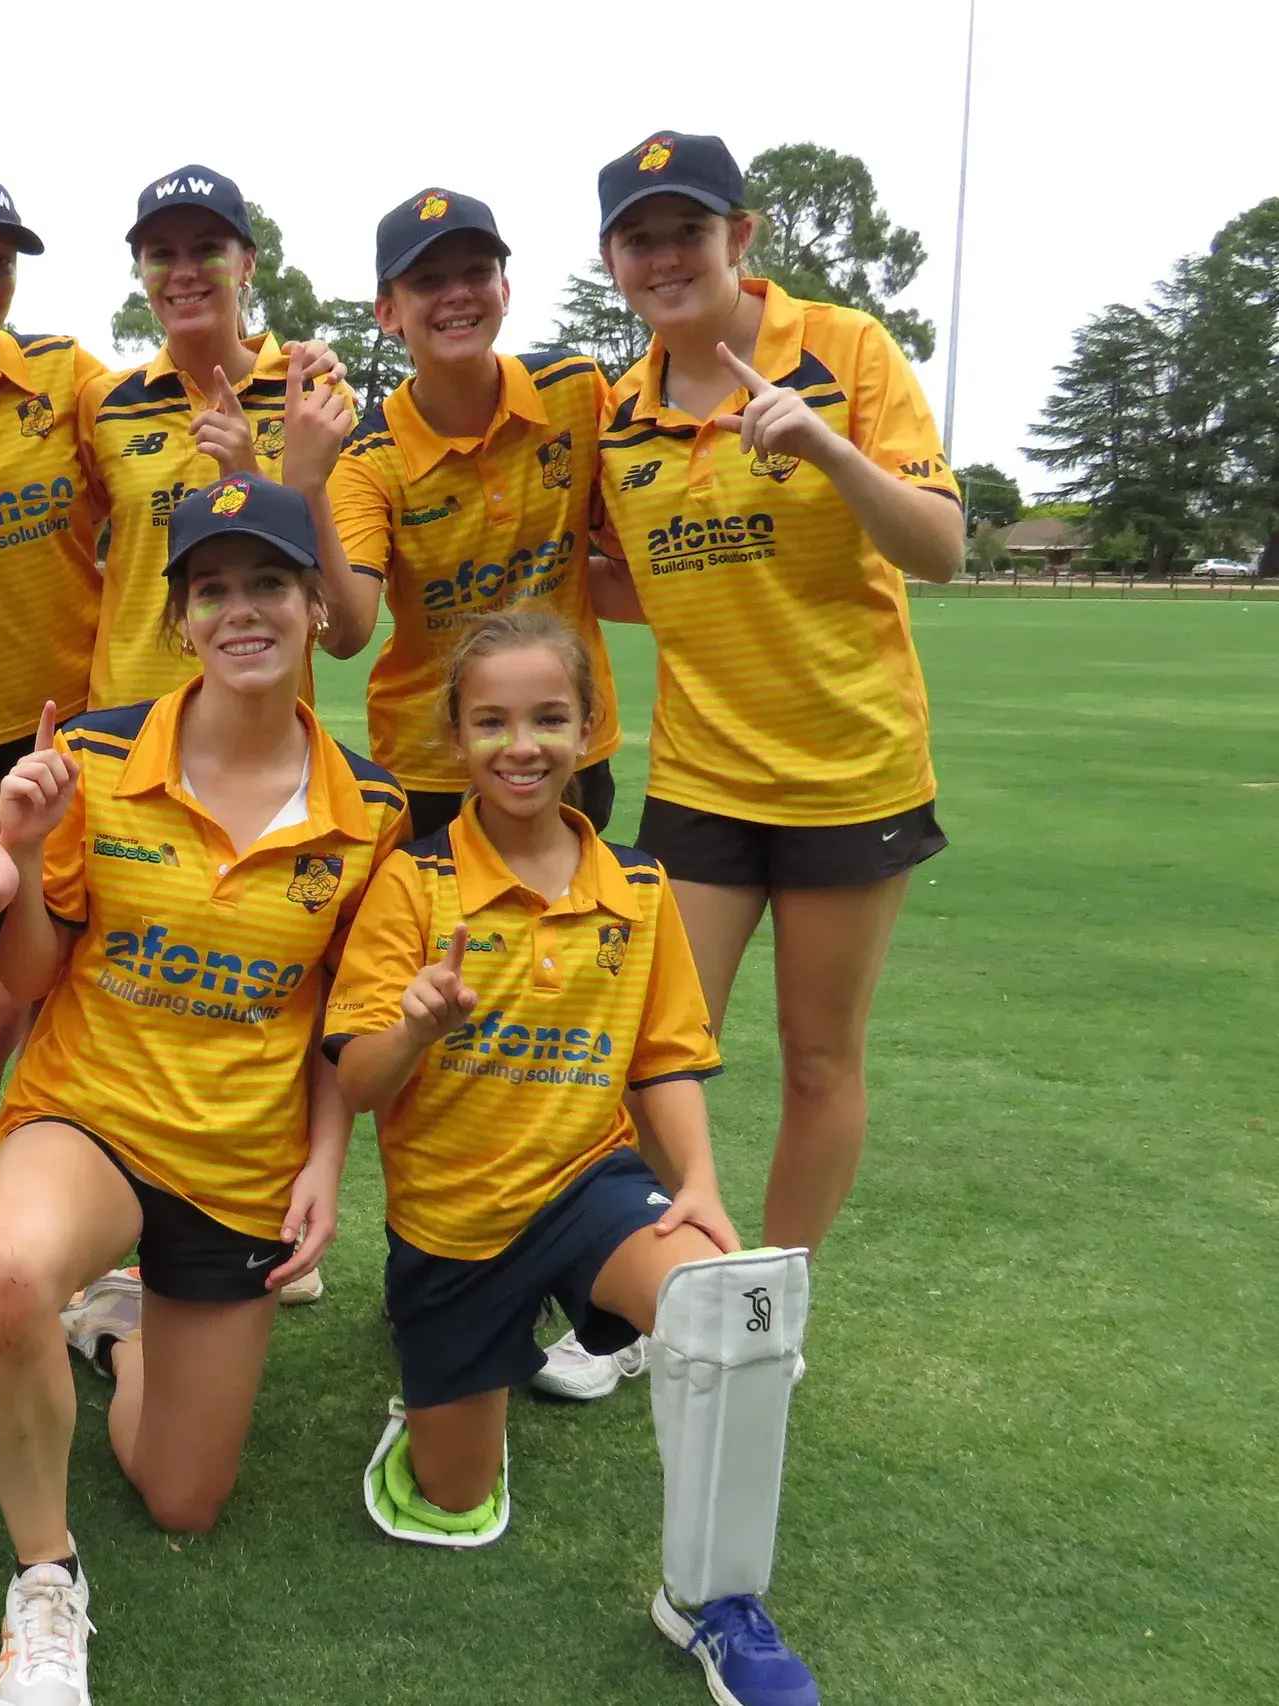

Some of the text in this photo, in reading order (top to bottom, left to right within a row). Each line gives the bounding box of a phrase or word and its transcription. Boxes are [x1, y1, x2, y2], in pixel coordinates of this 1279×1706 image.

[647, 513, 775, 556] afonso
[423, 531, 575, 611] afonso
[652, 558, 705, 576] Building
[707, 549, 763, 566] Solutions
[93, 838, 163, 864] kebabs
[104, 924, 305, 1000] afonso
[96, 967, 284, 1025] building solutions
[444, 1010, 613, 1064] afonso
[439, 1056, 526, 1085] building
